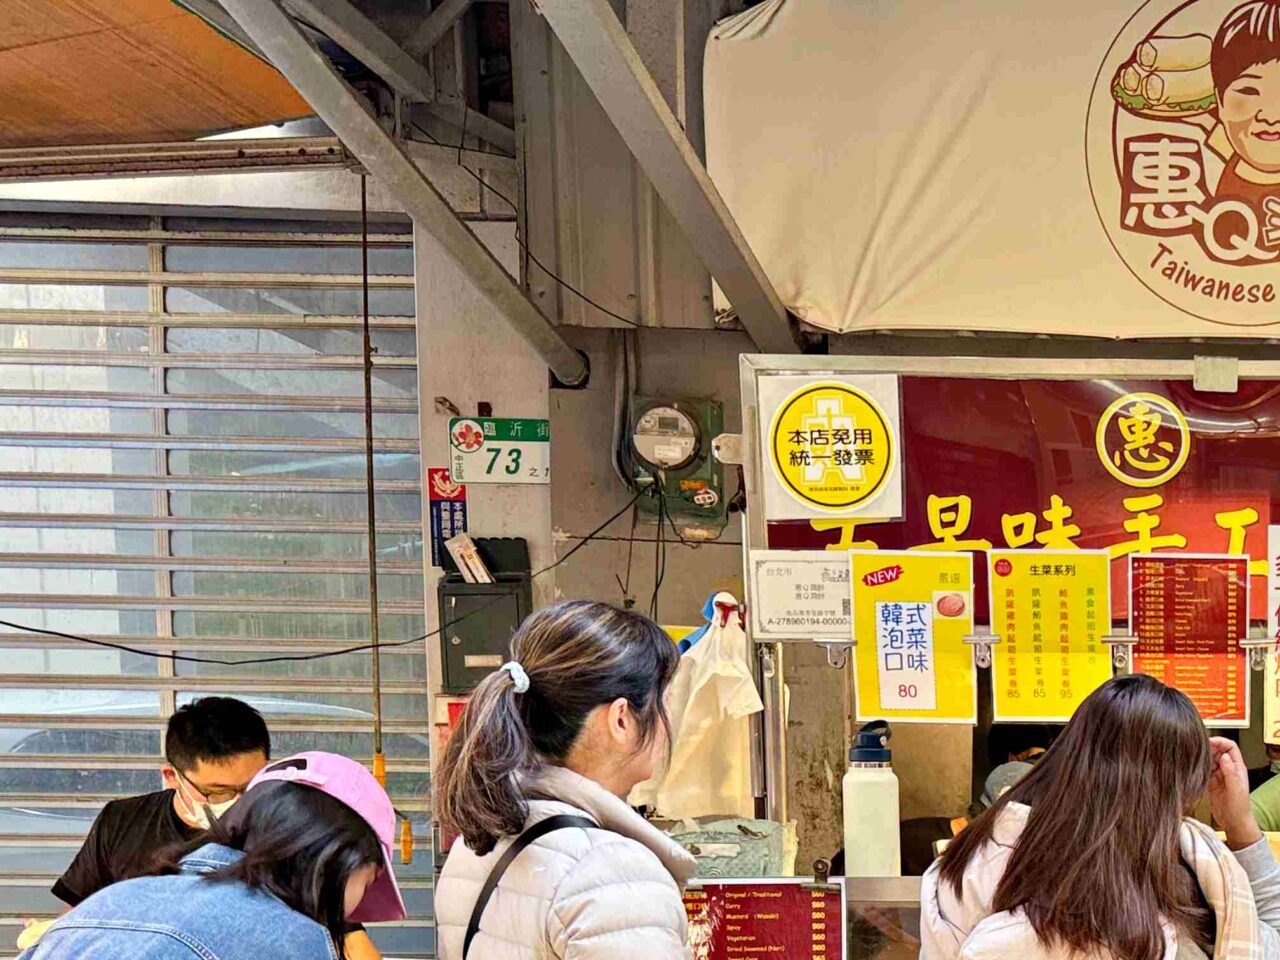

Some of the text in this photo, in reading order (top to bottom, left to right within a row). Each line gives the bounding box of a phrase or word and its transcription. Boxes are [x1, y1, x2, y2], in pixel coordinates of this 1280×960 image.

[1149, 243, 1277, 303] Taiwanese
[787, 428, 873, 447] 本店免用
[1115, 402, 1175, 472] 惠
[486, 447, 523, 475] 73
[789, 448, 876, 467] 統一發票
[866, 567, 899, 586] NEW
[1029, 564, 1077, 577] 生菜系列
[881, 603, 927, 627] 韓式
[882, 627, 928, 651] 泡菜
[884, 652, 929, 673] 口味
[898, 684, 918, 699] 80
[1033, 688, 1046, 698] 85
[1059, 688, 1073, 699] 95
